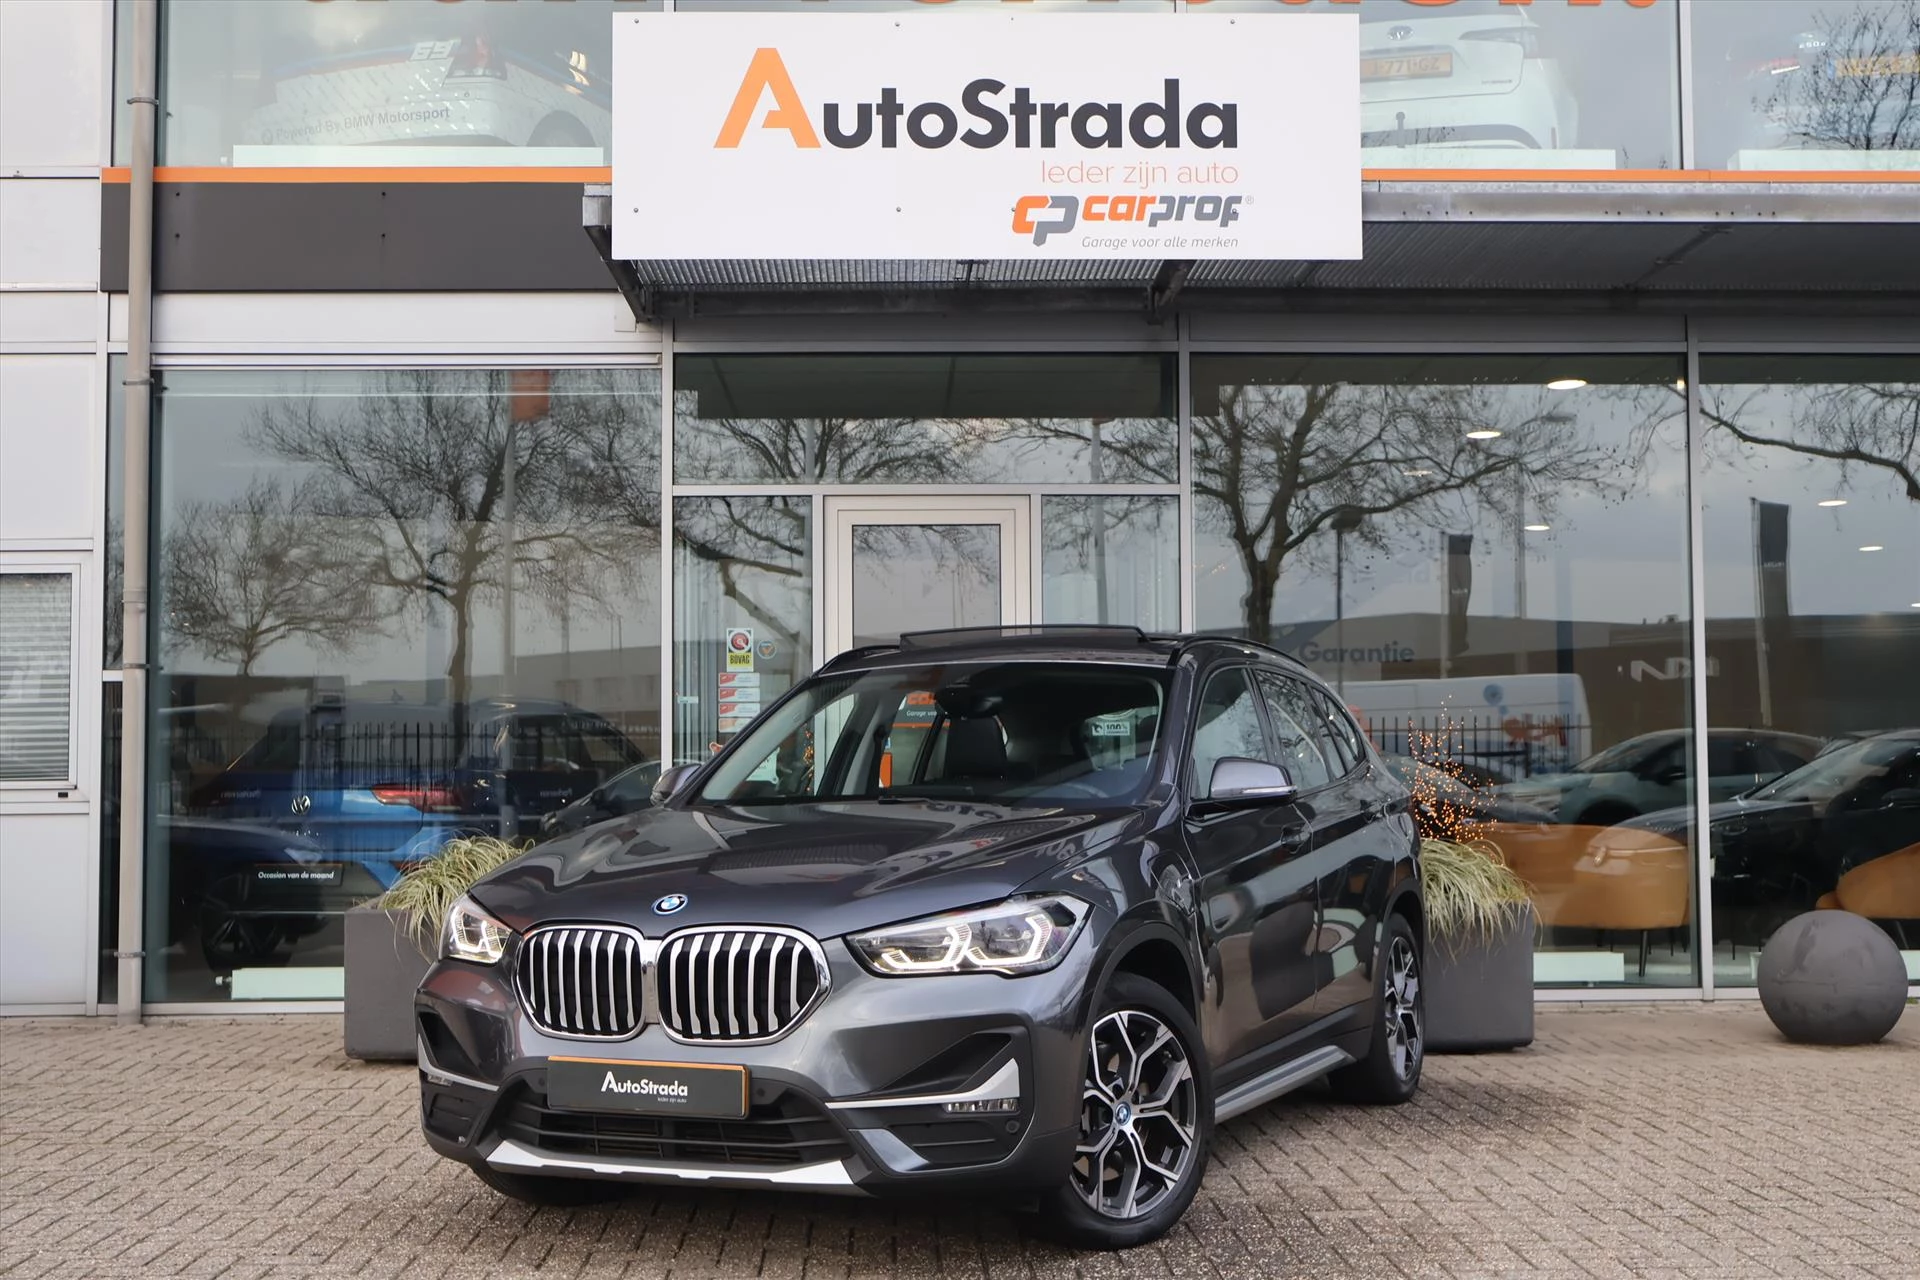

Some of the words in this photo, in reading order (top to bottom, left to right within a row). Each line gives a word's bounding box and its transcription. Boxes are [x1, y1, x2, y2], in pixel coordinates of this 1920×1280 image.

[714, 47, 1239, 150] AutoStrada
[275, 122, 321, 141] Powered
[325, 118, 340, 135] By
[344, 113, 374, 130] BMW
[377, 106, 451, 126] Motorsport
[1042, 160, 1116, 184] Ieder
[1123, 161, 1167, 189] zijn
[1177, 163, 1239, 184] auto
[1082, 236, 1127, 250] Garage
[1132, 238, 1161, 248] voor
[1164, 236, 1187, 248] alle
[1191, 236, 1239, 248] merken
[729, 654, 750, 665] BOVAG
[1300, 640, 1415, 662] Garantie
[258, 871, 286, 879] Occasion
[301, 871, 309, 879] de
[310, 871, 335, 879] maand
[601, 1071, 688, 1097] AutoStrada
